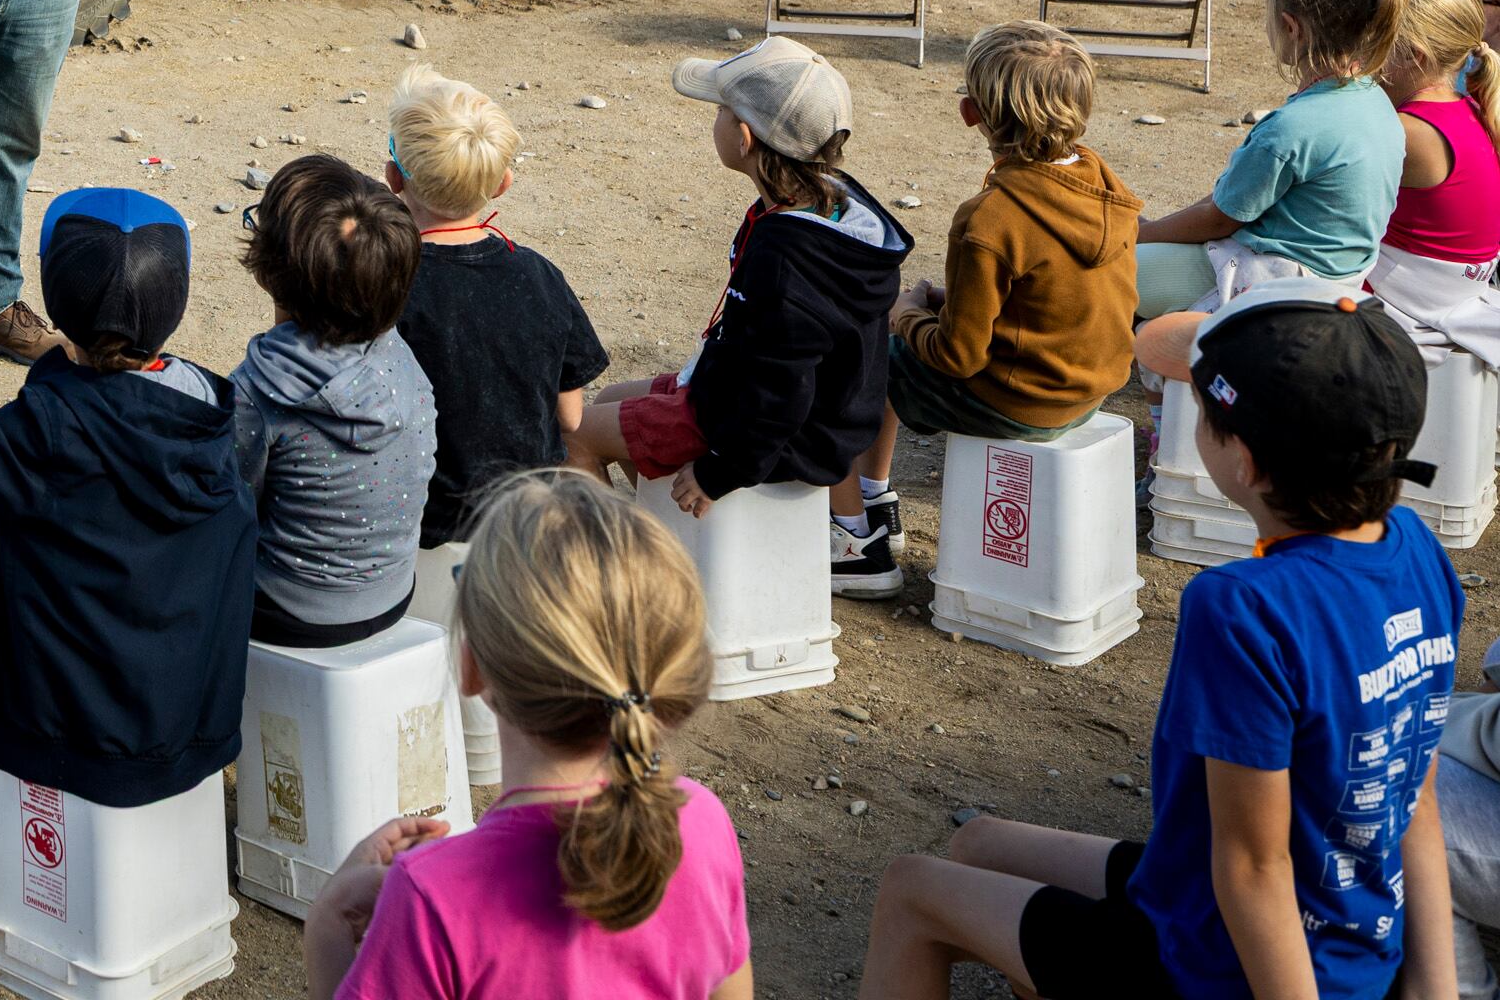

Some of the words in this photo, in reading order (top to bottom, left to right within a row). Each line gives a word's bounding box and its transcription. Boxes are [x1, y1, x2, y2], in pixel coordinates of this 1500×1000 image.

[986, 548, 1018, 561] WARNING
[1358, 660, 1396, 704] BUILT
[1394, 647, 1420, 684] FOR
[1416, 633, 1456, 669] THIS
[26, 895, 58, 916] WARNING
